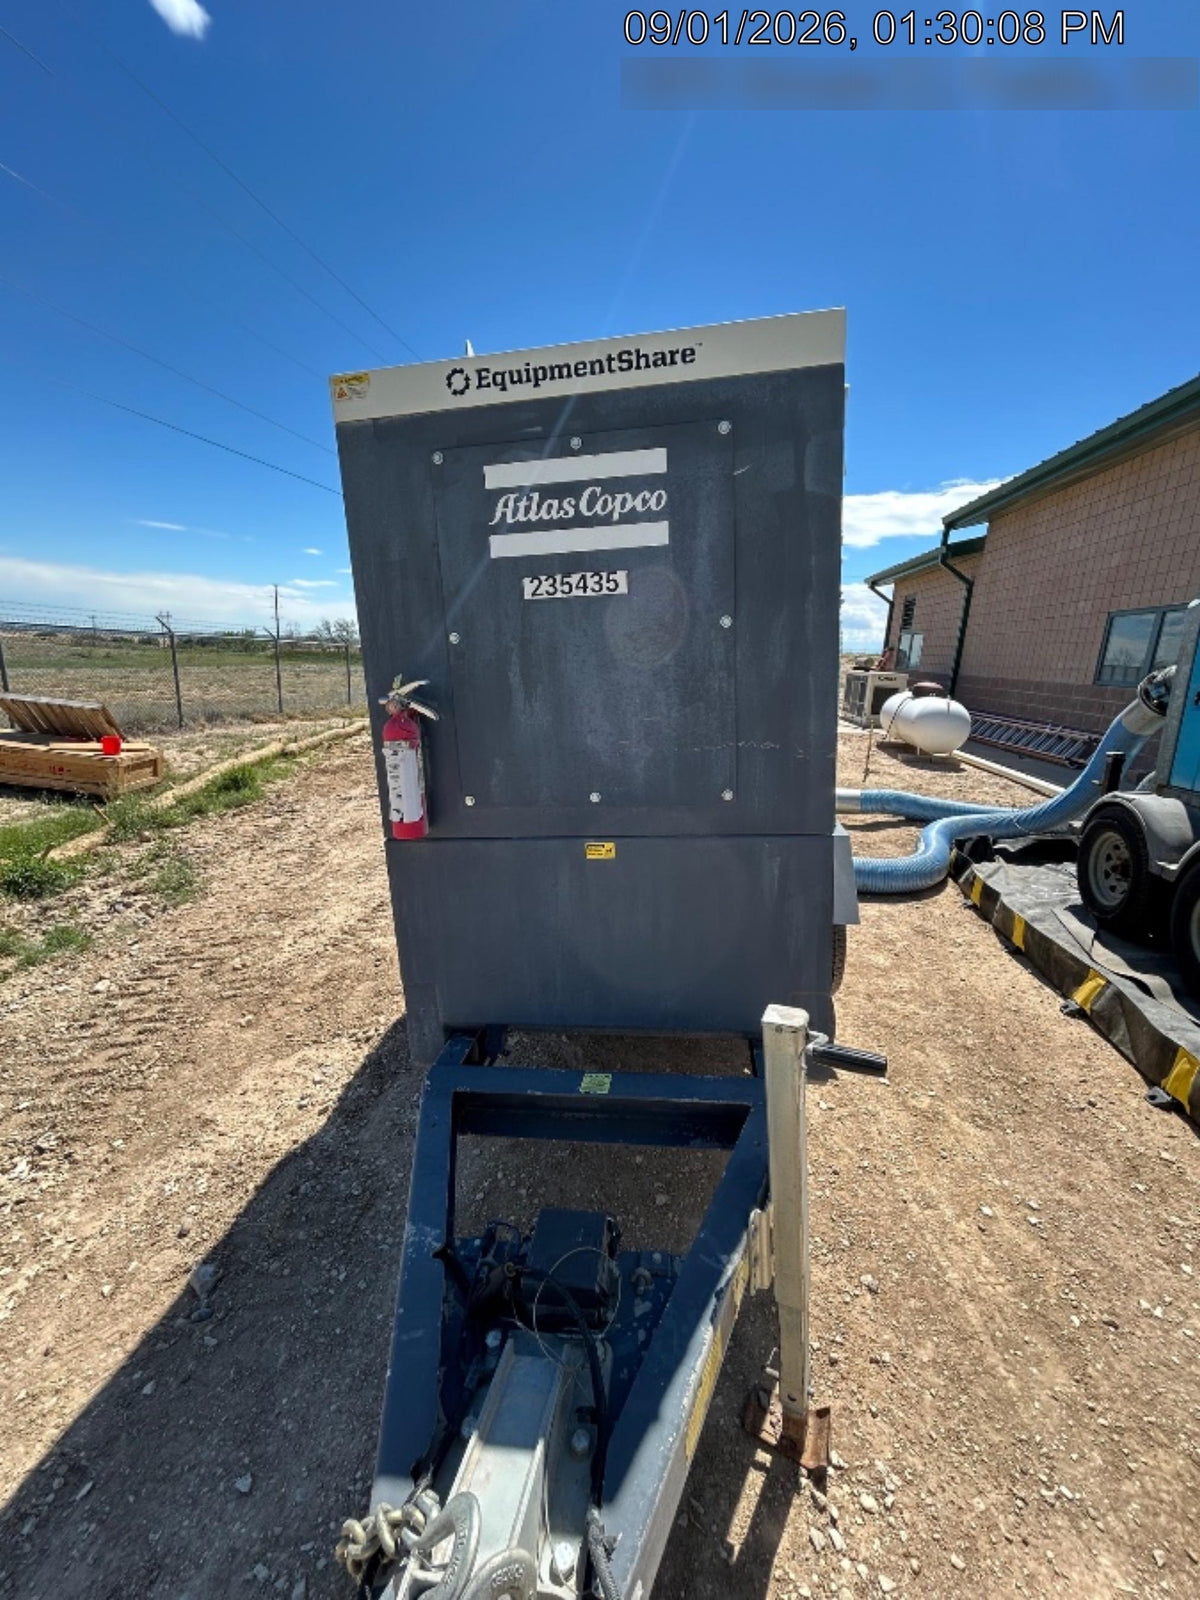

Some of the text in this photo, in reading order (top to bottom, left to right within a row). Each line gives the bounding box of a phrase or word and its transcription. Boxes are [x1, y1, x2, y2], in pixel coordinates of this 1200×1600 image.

[475, 347, 696, 391] EquipmentShare
[488, 487, 667, 525] Atlas Copco
[529, 572, 619, 597] 235435
